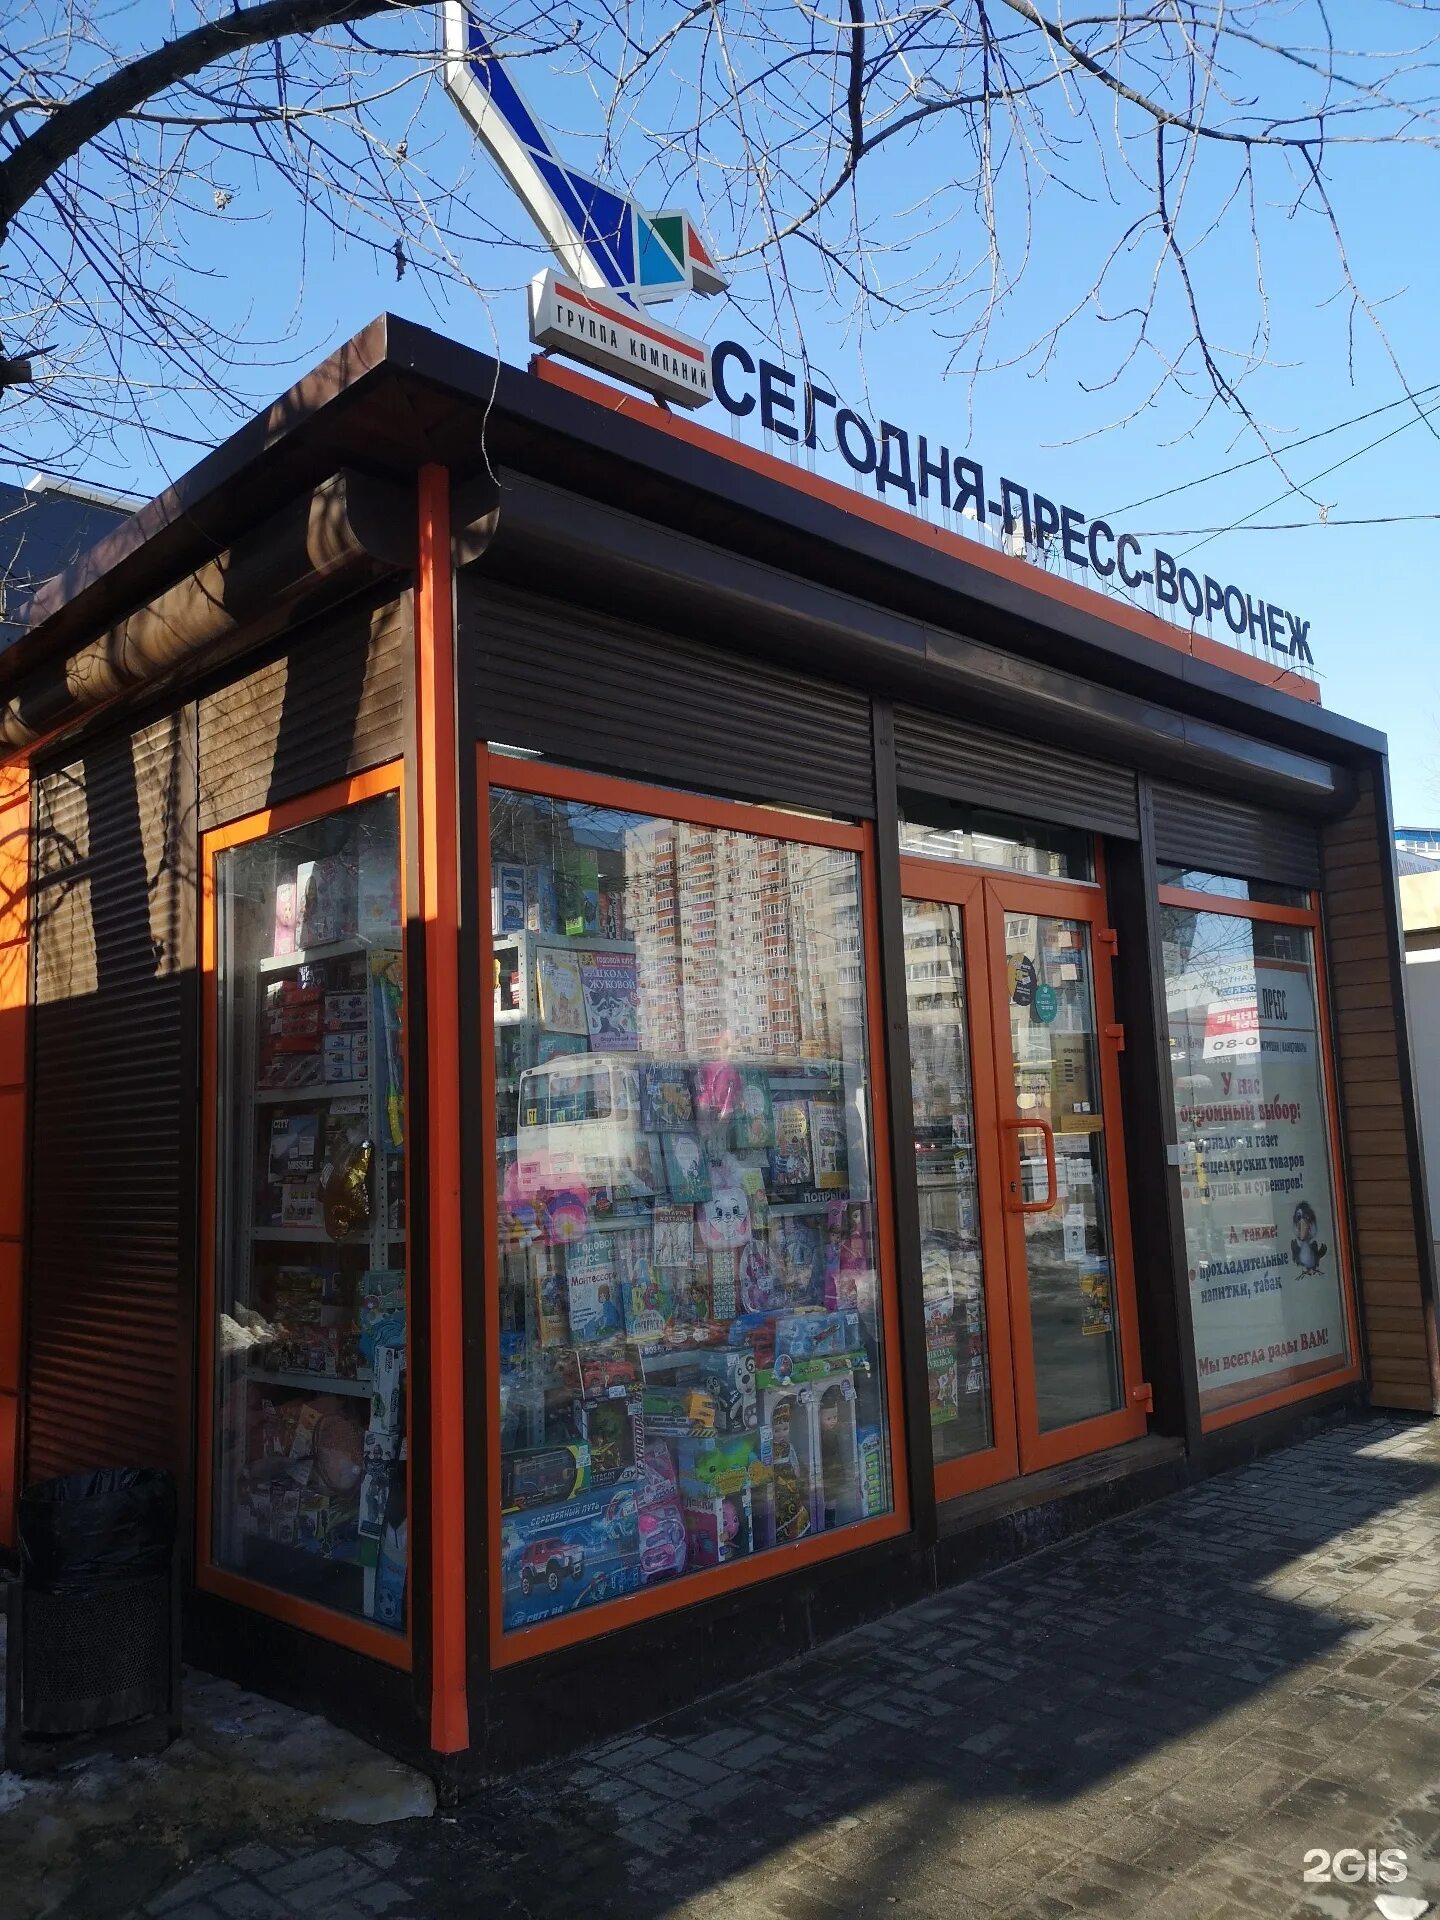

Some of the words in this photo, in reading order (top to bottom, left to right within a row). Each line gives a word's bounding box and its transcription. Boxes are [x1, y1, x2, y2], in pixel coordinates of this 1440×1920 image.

[556, 303, 619, 350] ГРУППА
[629, 338, 708, 391] КОМПАНИЙ
[589, 978, 636, 990] ЖУКОВОЙ
[594, 969, 630, 980] ШКОЛА
[1221, 1071, 1233, 1096] У
[1236, 1078, 1260, 1096] нас
[272, 1118, 290, 1129] CITY
[1255, 1133, 1280, 1149] газет
[287, 1159, 315, 1171] MISSILE
[1268, 1153, 1305, 1174] товаров
[1254, 1172, 1304, 1198] сувениров!
[1229, 1229, 1239, 1245] А
[1199, 1251, 1290, 1281] прохладительные
[570, 1272, 618, 1287] Монтессори
[1200, 1281, 1252, 1304] напитки,
[1253, 1271, 1283, 1295] табак
[1198, 1357, 1221, 1377] Мы
[1222, 1347, 1266, 1371] всегда
[1267, 1338, 1299, 1367] рады
[1300, 1326, 1330, 1352] ВАМ!
[530, 1507, 581, 1527] СЕРЕБРЯНЫЙ
[581, 1501, 601, 1514] ПУТЬ
